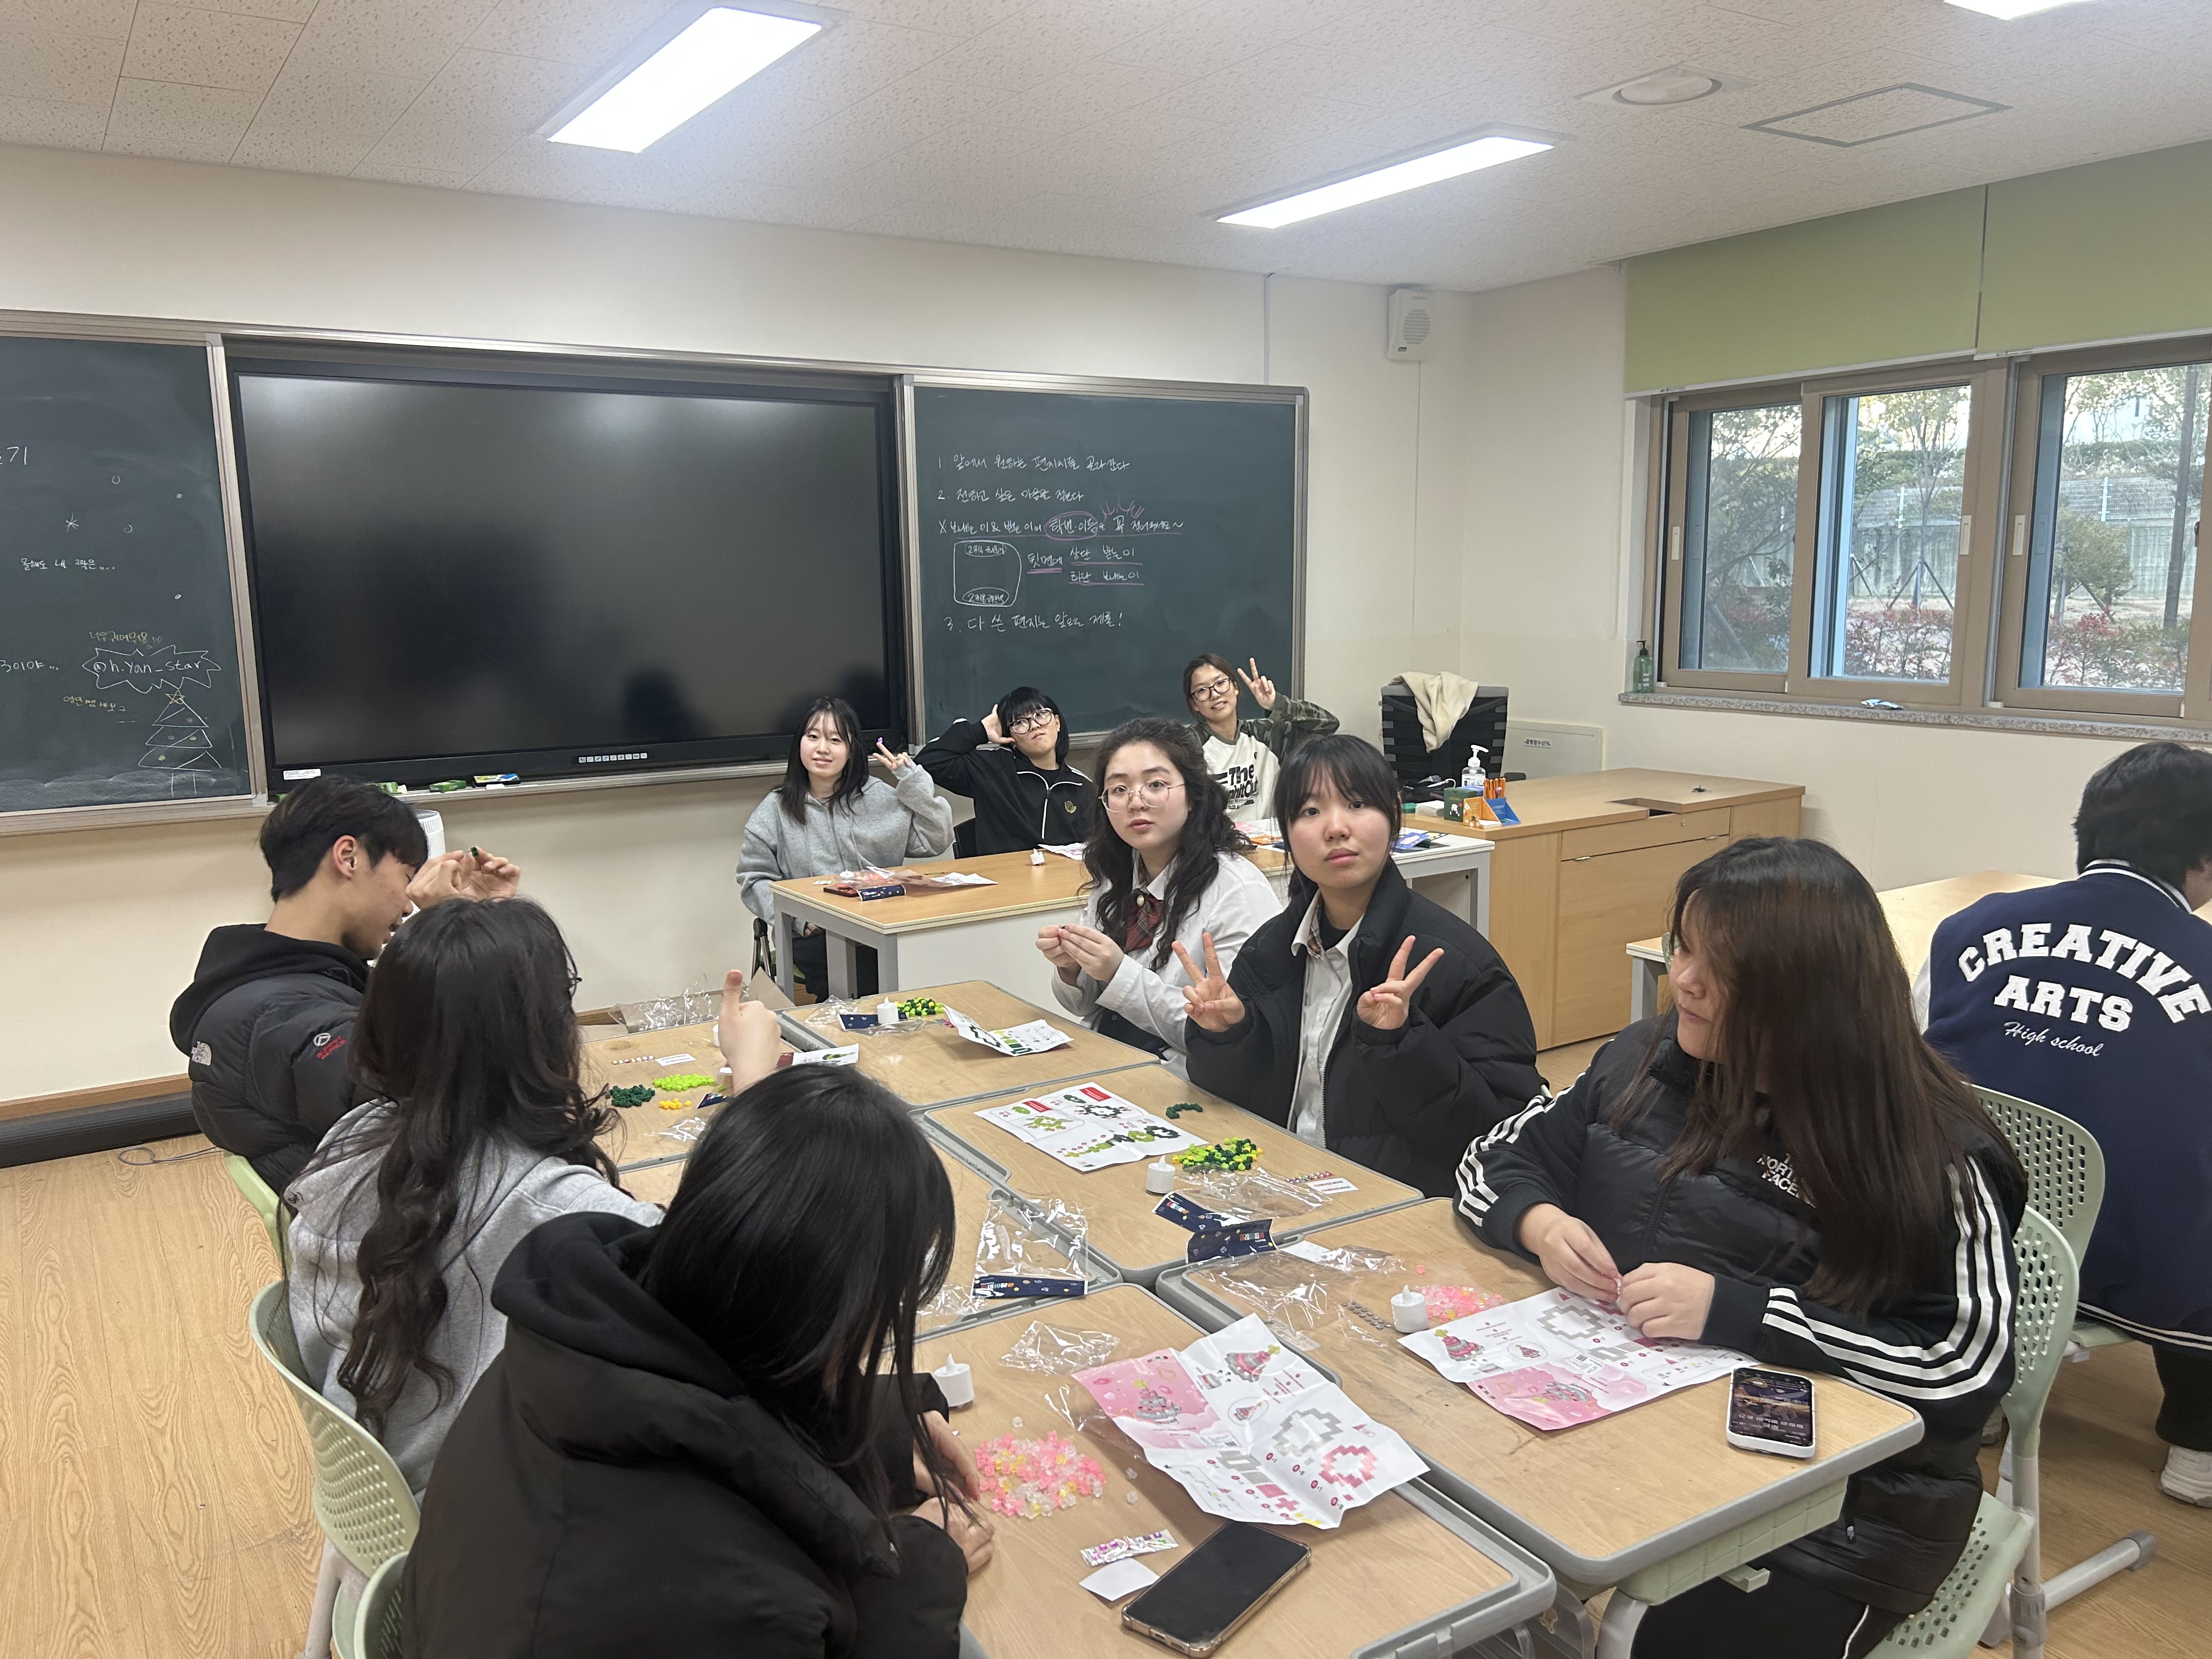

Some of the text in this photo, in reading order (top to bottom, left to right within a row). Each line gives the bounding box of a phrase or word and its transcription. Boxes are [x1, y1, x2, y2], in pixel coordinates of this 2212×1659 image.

[953, 453, 987, 471] 앞에서
[994, 455, 1027, 469] 원하는
[1031, 455, 1080, 471] 편지지를
[956, 488, 990, 503] 전하고
[995, 488, 1016, 502] 싶은
[1021, 488, 1051, 501] 마음을
[1113, 515, 1124, 534] 꼭
[1028, 552, 1063, 568] 뒷면에
[1070, 546, 1091, 560] 상단
[20, 557, 48, 571] 올해도
[54, 559, 66, 569] 내
[1070, 571, 1092, 583] 하단
[967, 616, 985, 631] 다
[991, 614, 1006, 632] 쓴
[1011, 614, 1050, 629] 편지는
[1054, 611, 1084, 628] 앞으로
[1229, 764, 1254, 786] The
[1958, 923, 2212, 1023] CREATIVE
[1994, 974, 2134, 1032] ARTS
[2004, 1021, 2104, 1057] High school
